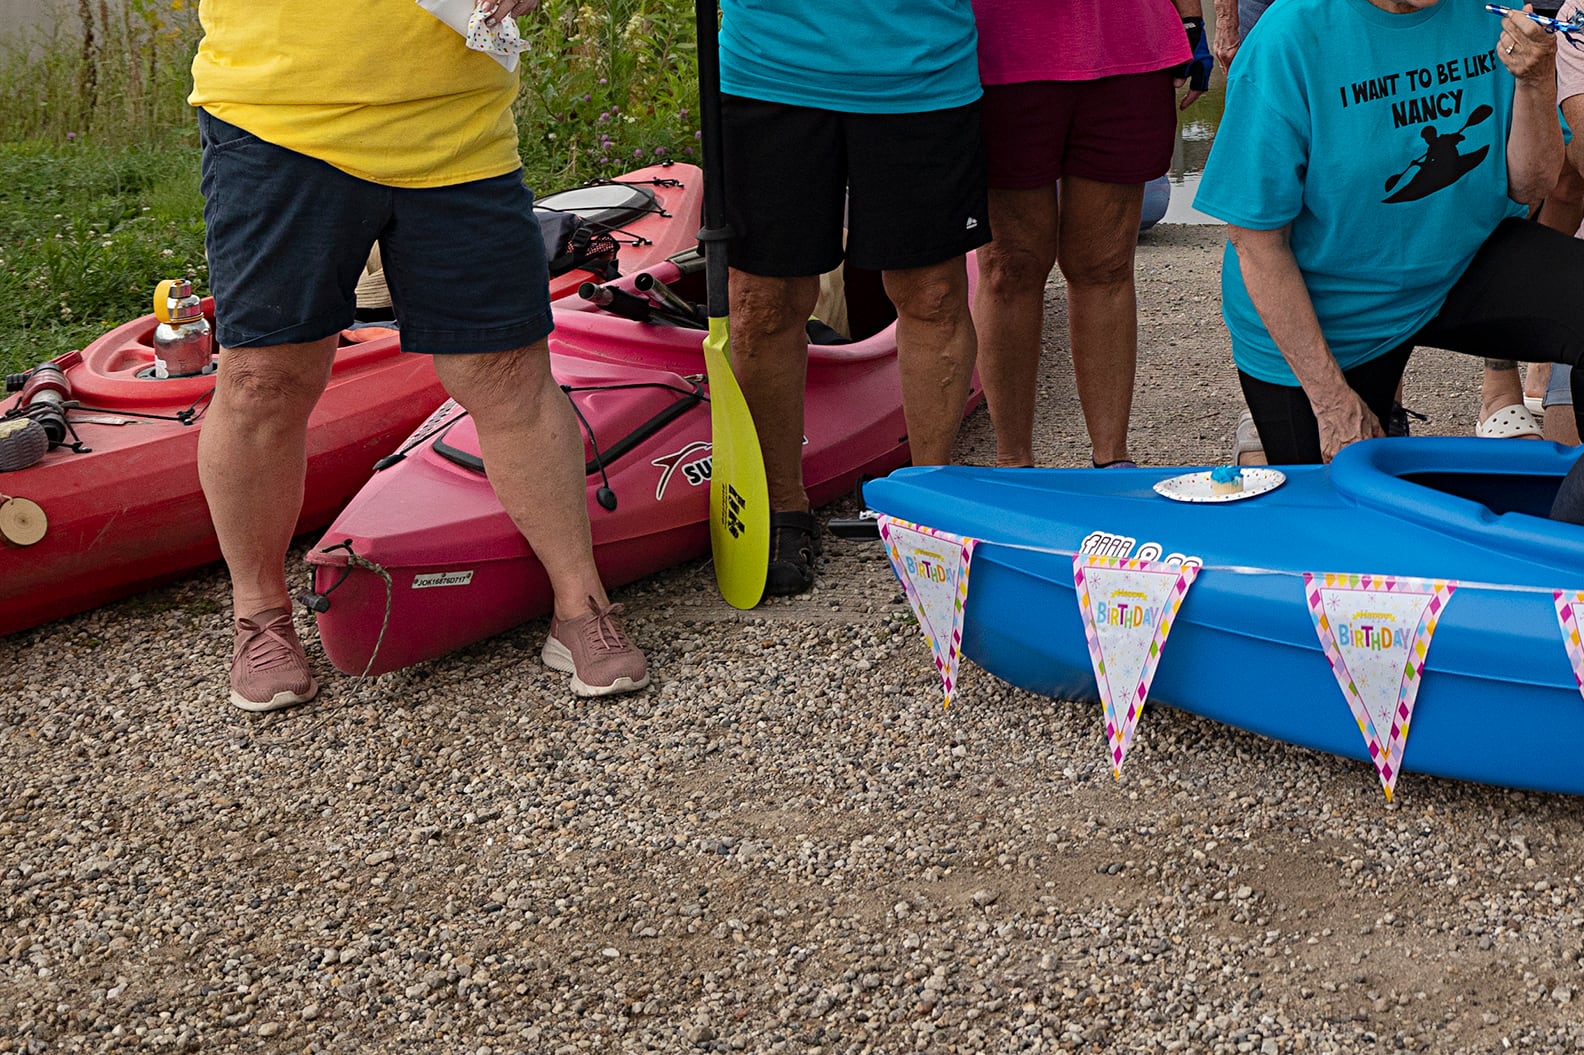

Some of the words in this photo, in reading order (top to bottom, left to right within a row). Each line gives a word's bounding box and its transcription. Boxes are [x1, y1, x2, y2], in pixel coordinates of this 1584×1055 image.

[1340, 86, 1348, 108] I
[1352, 73, 1400, 104] WANT
[1406, 68, 1432, 91] TO
[1436, 59, 1461, 85] BE
[1464, 49, 1497, 79] LIKE
[1391, 89, 1463, 129] NANCY
